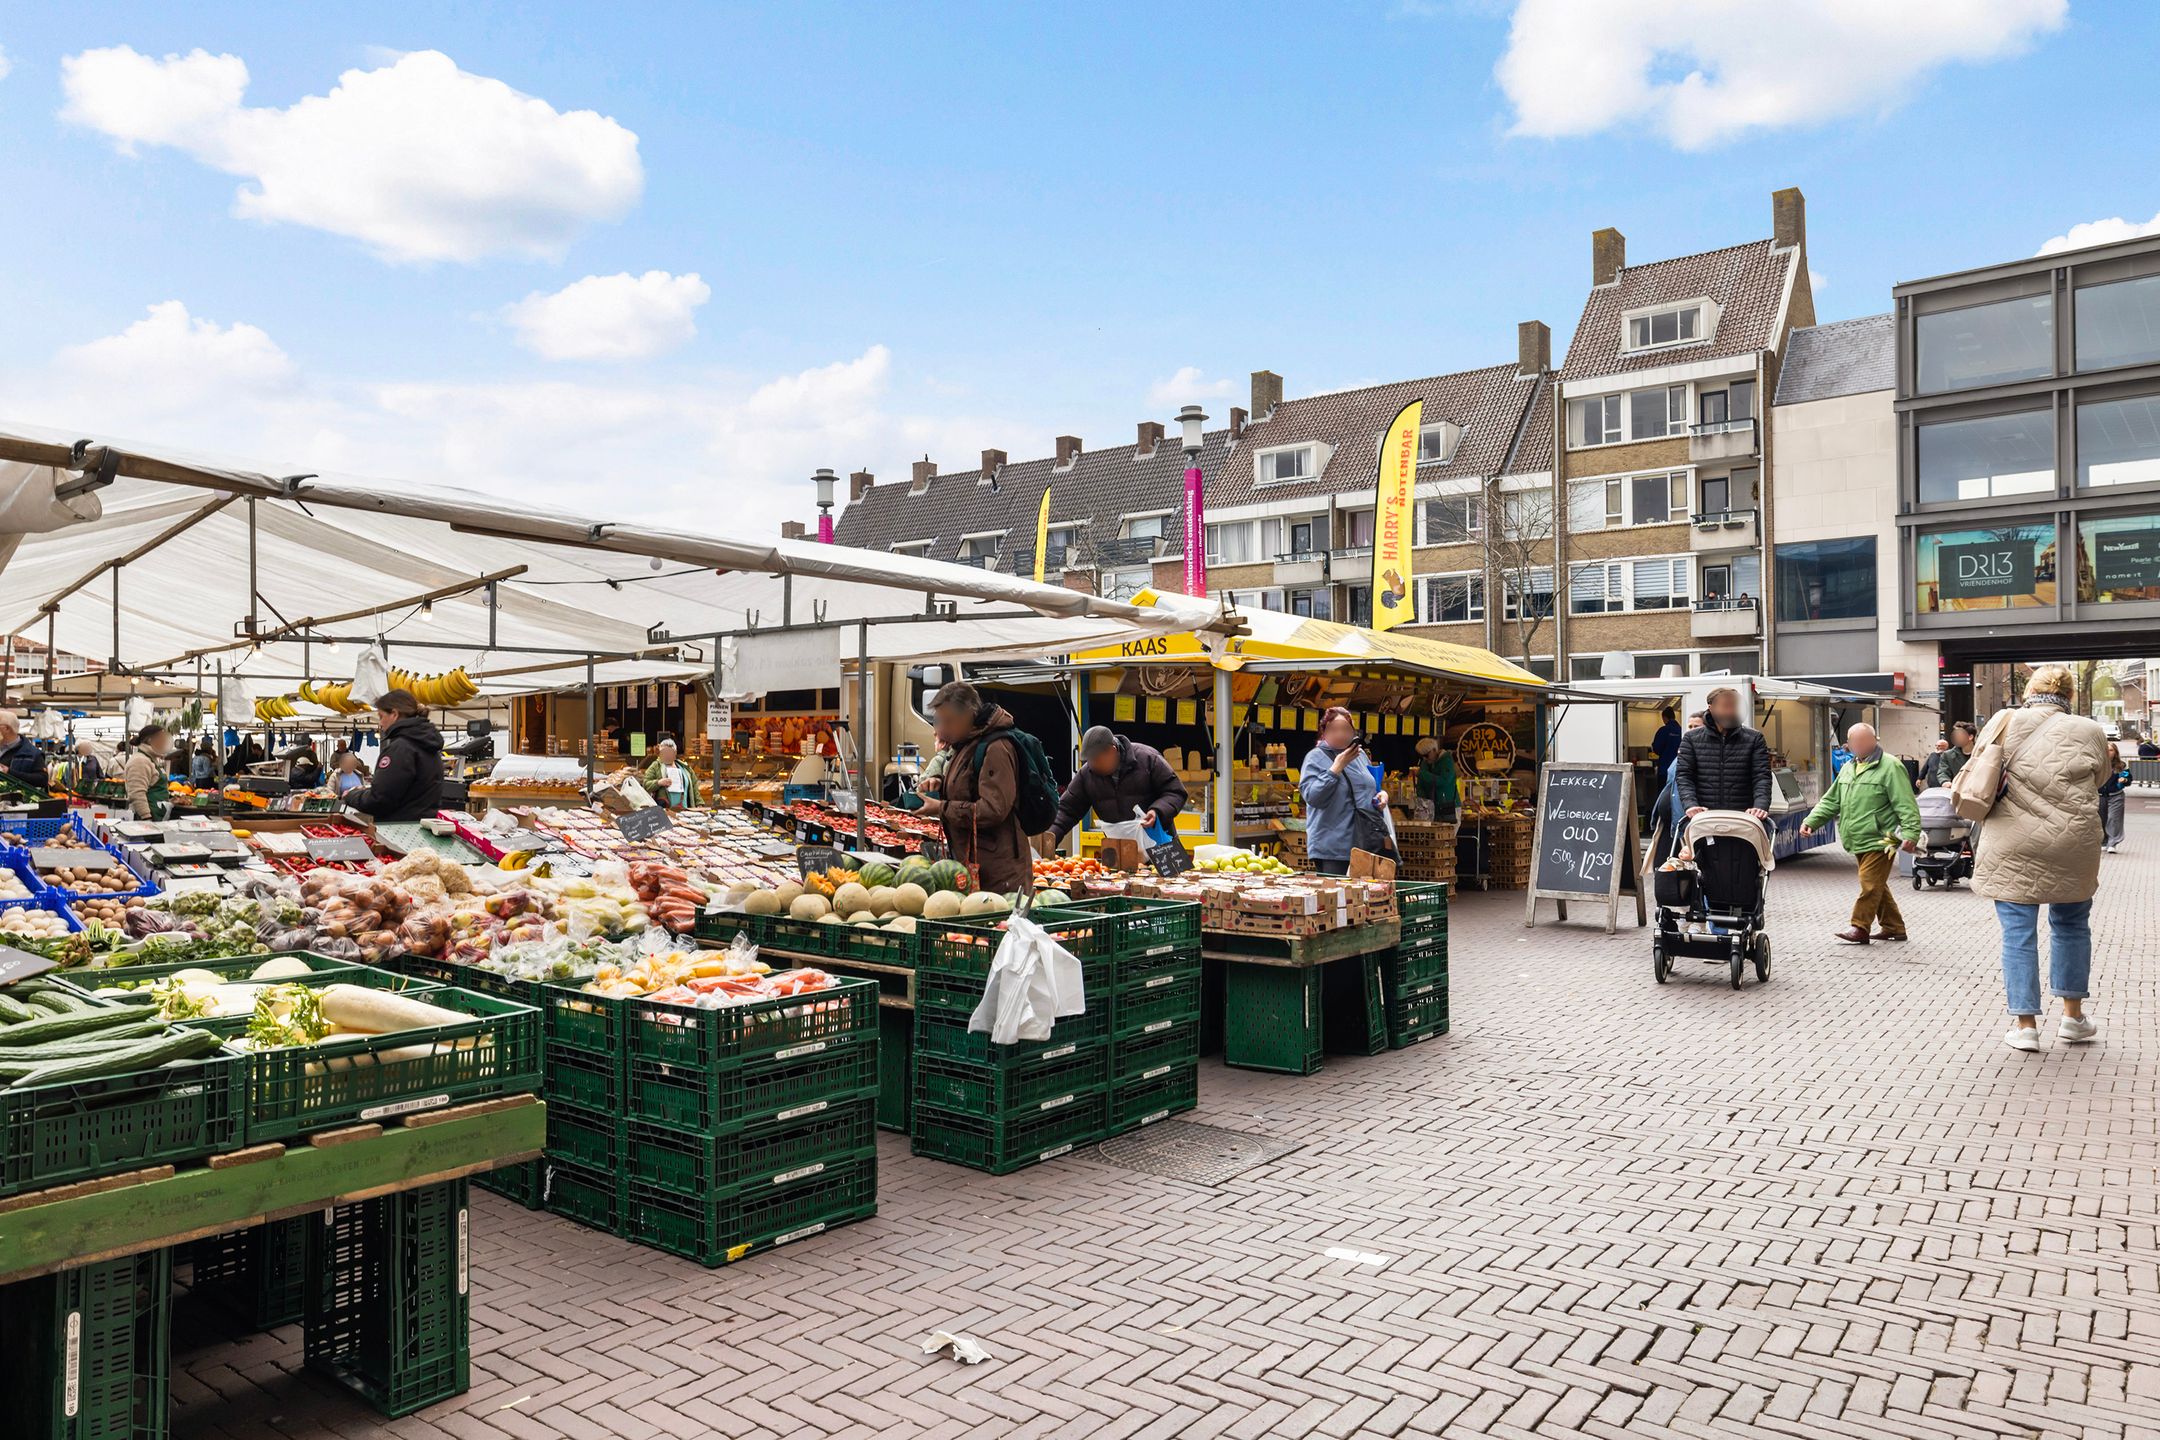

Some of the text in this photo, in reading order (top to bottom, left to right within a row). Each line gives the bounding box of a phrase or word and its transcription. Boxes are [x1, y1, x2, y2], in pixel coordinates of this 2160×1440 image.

[1399, 429, 1413, 507] NOTENBAR
[1382, 496, 1399, 561] HARRY'S
[1960, 578, 2013, 587] VRIENDENHOF
[1122, 638, 1167, 656] KAAS
[1461, 737, 1509, 751] SMAAK
[1549, 799, 1613, 822] WEIDEVOGEL
[1562, 826, 1599, 843] OUD
